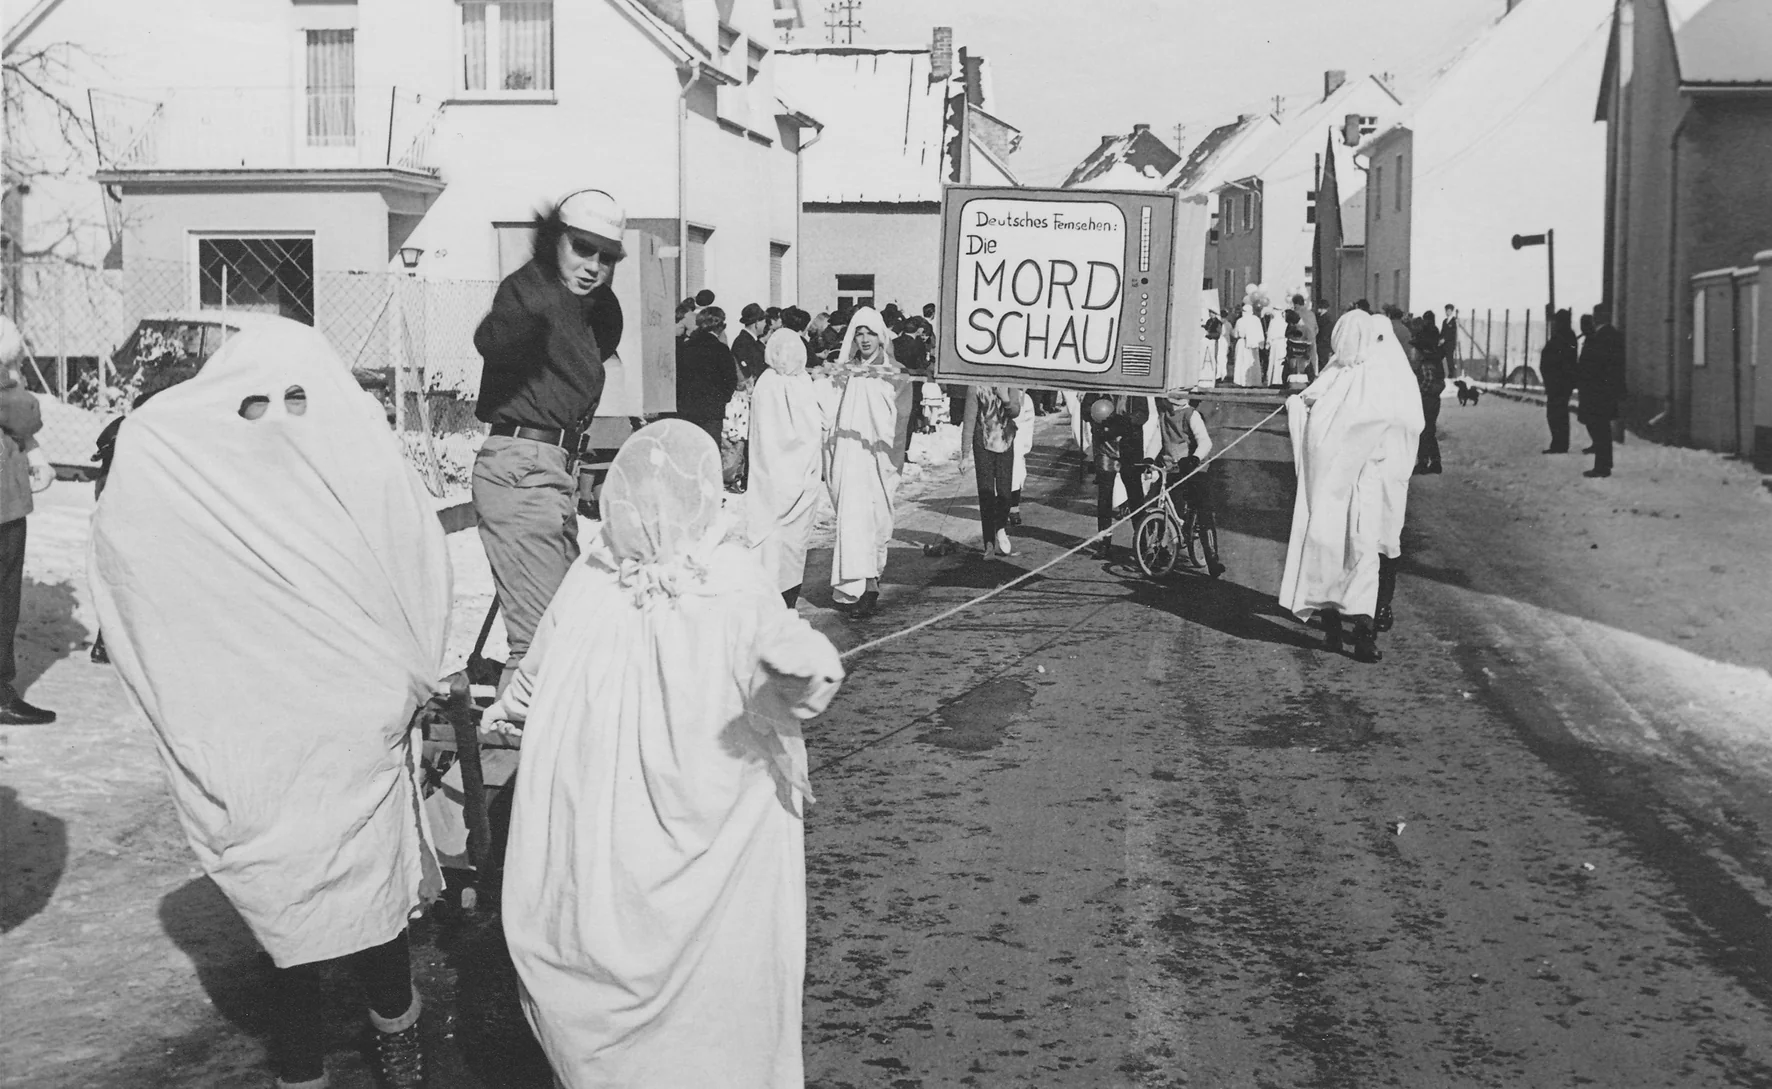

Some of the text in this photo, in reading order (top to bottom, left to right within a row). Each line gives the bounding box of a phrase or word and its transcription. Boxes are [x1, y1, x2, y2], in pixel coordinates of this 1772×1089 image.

[975, 211, 1118, 232] Deutsches Fernsehen:
[965, 234, 998, 255] Die
[973, 258, 1121, 311] MORD
[965, 307, 1115, 364] SCHAU
